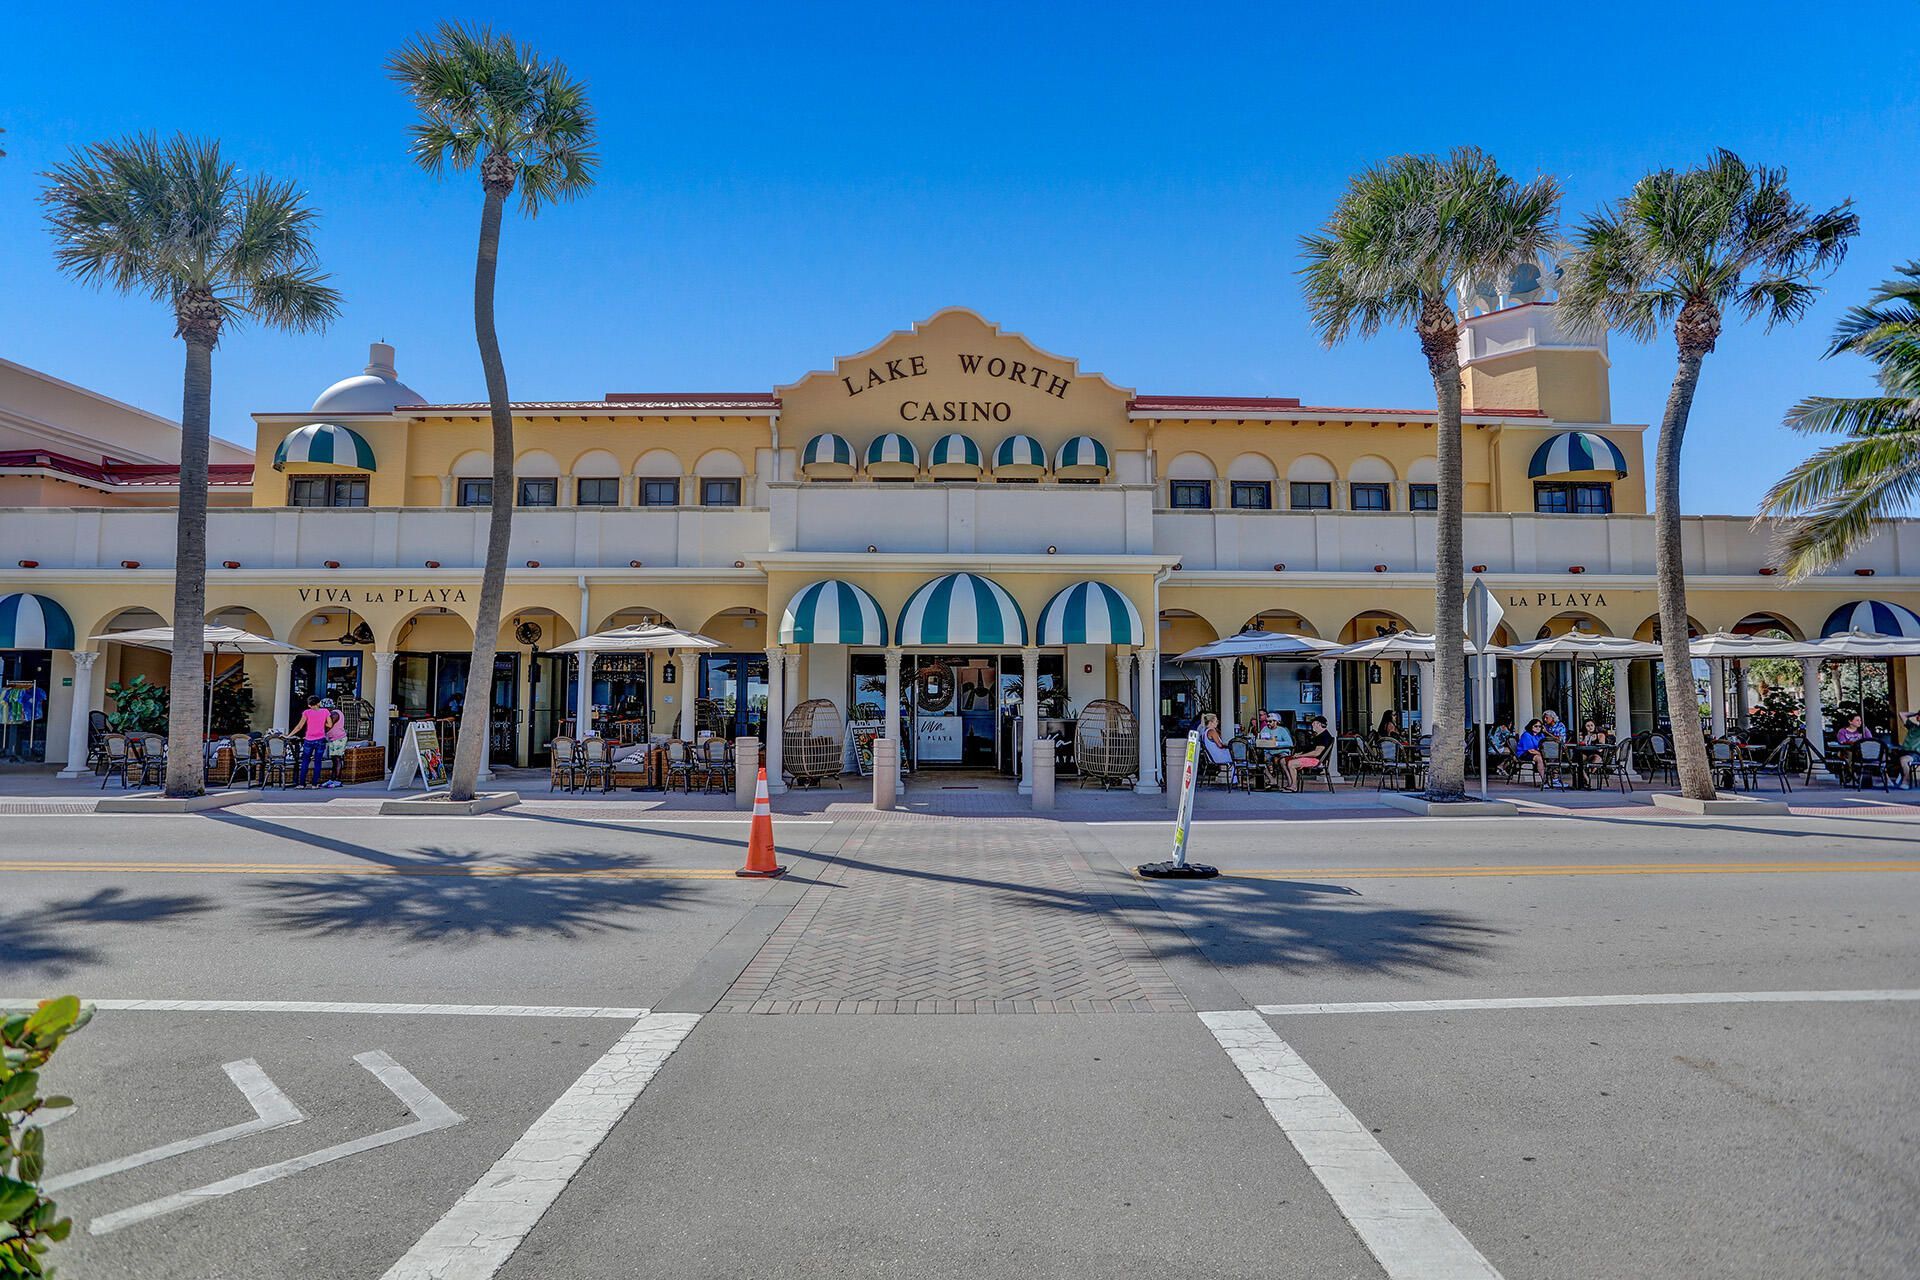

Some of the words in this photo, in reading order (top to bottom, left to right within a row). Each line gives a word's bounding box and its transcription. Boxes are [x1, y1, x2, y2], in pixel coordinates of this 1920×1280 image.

[842, 355, 928, 397] LAKE
[958, 354, 1071, 399] WORTH
[900, 401, 1011, 422] CASINO
[298, 589, 352, 602] VIVA
[366, 592, 384, 602] LA
[394, 589, 466, 602] PLAYA
[1510, 596, 1528, 607] LA
[1537, 593, 1607, 607] PLAYA
[1055, 755, 1075, 763] AYA
